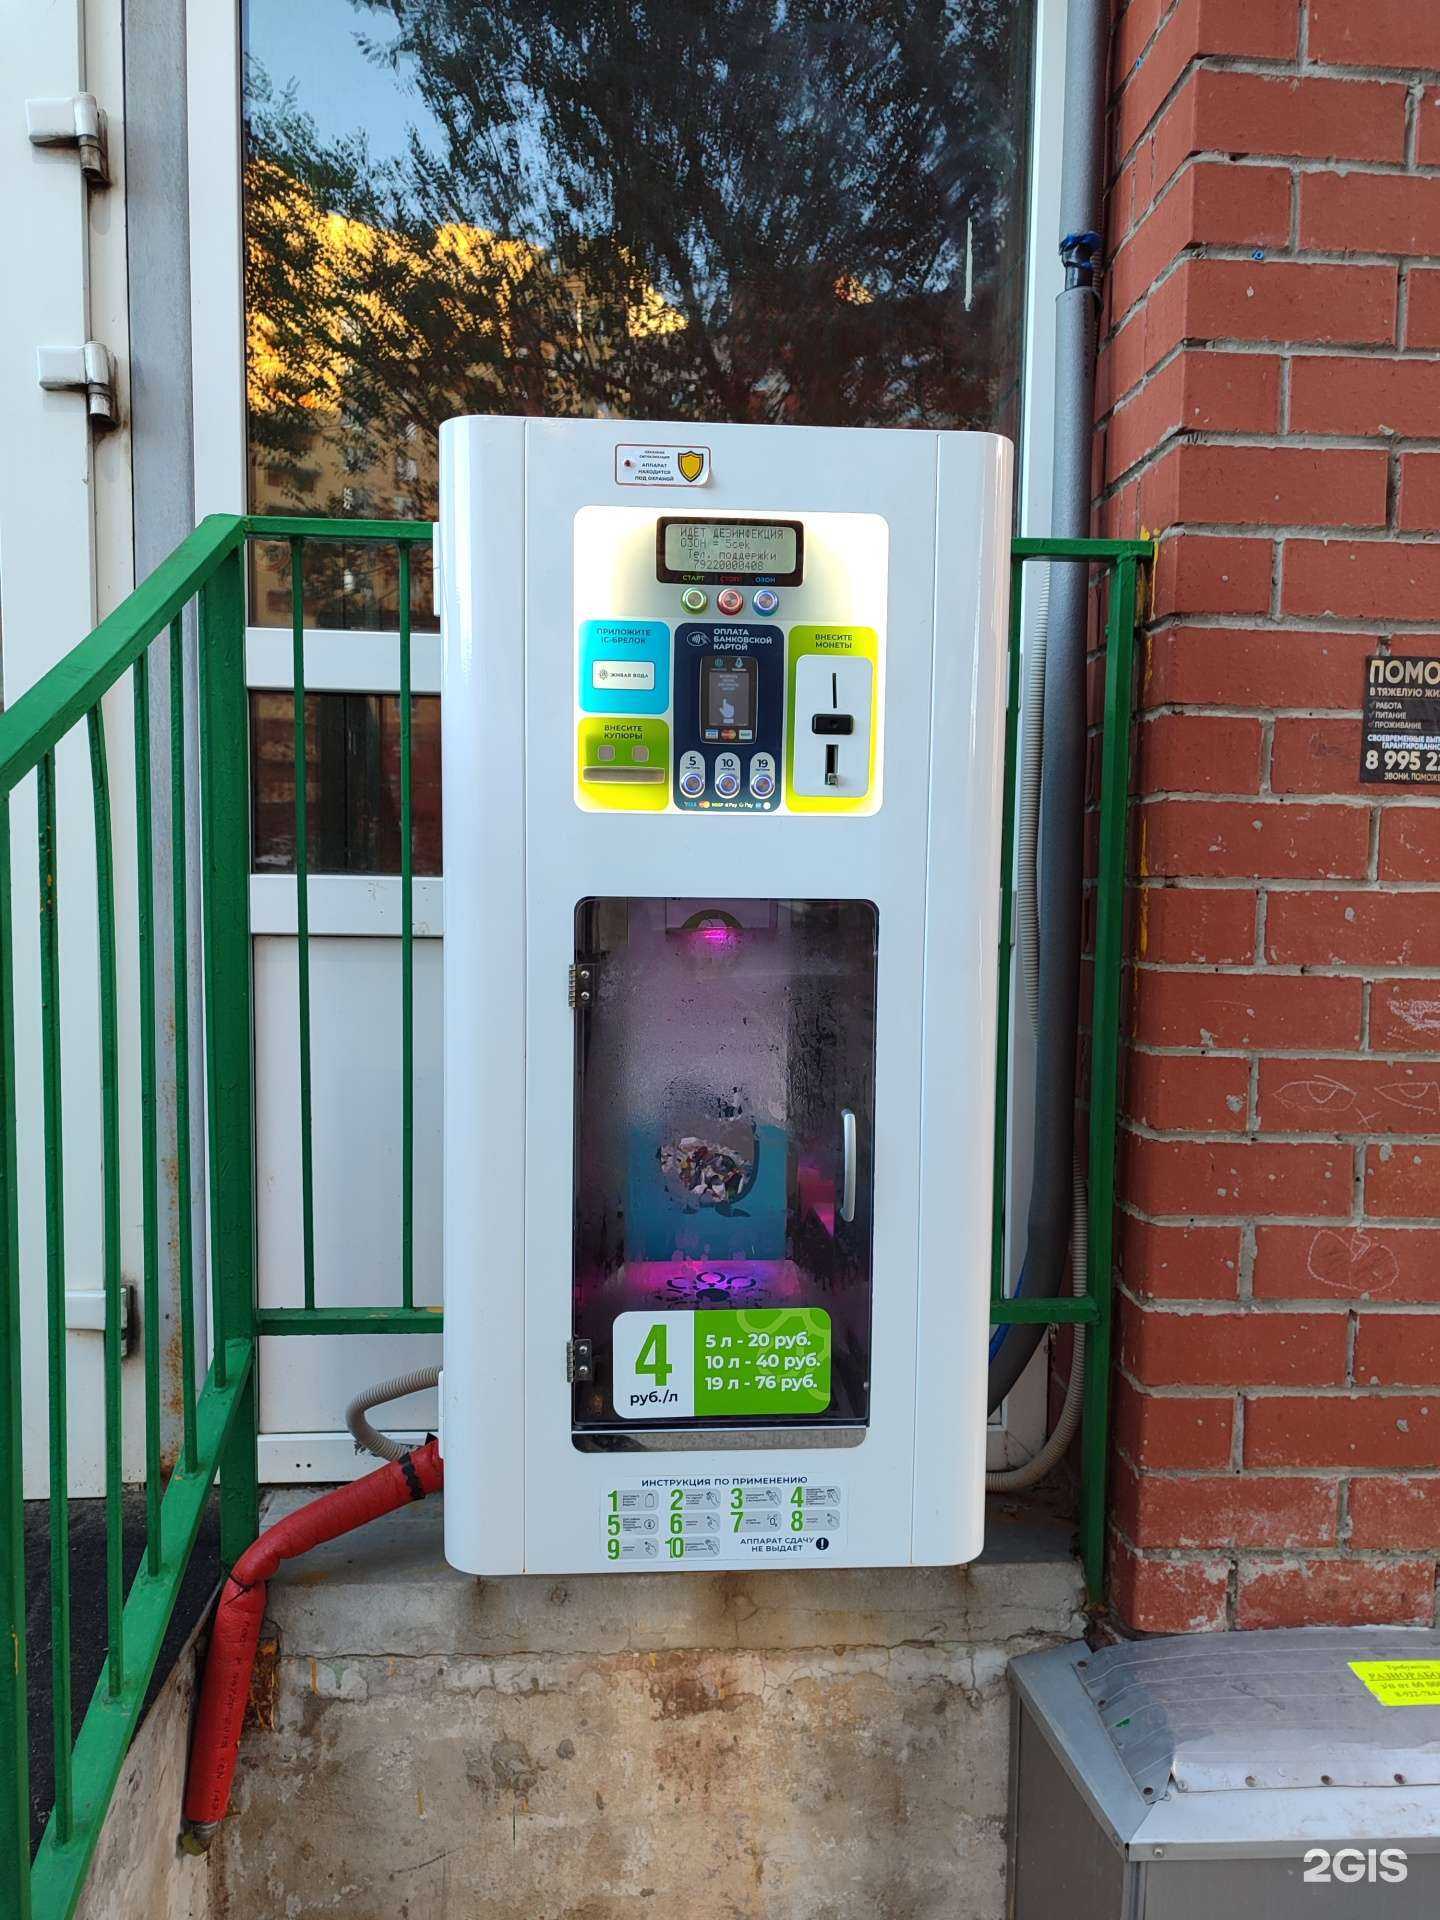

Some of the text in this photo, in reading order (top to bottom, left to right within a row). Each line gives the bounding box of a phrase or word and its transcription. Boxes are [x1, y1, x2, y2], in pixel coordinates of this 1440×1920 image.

[680, 527, 784, 540] ИДЕТ ДЕЗИНФЕКЦИЯ
[680, 538, 706, 548] ОЗОН
[688, 549, 777, 560] Тел. поддержки
[597, 628, 652, 636] ПРИЛОЖИТЕ
[713, 636, 772, 644] БАНКОВСКОЙ
[1369, 688, 1376, 696] В
[1377, 688, 1422, 697] ТЯЖЕЛУЮ
[1375, 702, 1402, 710] РАБОТА
[1375, 711, 1406, 719] ПИТАНИЕ
[1374, 721, 1421, 729] ПРОЖИВАНИЕ
[689, 756, 697, 766] 5
[722, 758, 734, 768] 10
[756, 759, 768, 768] 19
[1365, 750, 1440, 771] 8 995 2
[705, 1335, 716, 1348] 5
[720, 1337, 732, 1347] л
[748, 1334, 770, 1347] 20
[775, 1332, 811, 1349] руб.
[634, 1324, 673, 1387] 4
[705, 1356, 724, 1369] 10
[728, 1357, 740, 1369] л
[756, 1355, 779, 1368] 40
[784, 1353, 821, 1370] руб.
[705, 1377, 724, 1390] 19
[727, 1378, 739, 1390] л
[755, 1376, 777, 1389] 76
[781, 1374, 818, 1392] руб.
[630, 1390, 678, 1406] руб./л
[641, 1479, 711, 1487] ИНСТРУКЦИЯ
[732, 1476, 808, 1485] ПРИМЕНЕНИЮ
[608, 1490, 618, 1512] 1
[670, 1489, 683, 1511] 2
[730, 1487, 743, 1509] 3
[790, 1486, 804, 1508] 4
[608, 1514, 620, 1536] 5
[670, 1513, 683, 1534] 6
[730, 1511, 744, 1533] 7
[790, 1510, 803, 1532] 8
[608, 1538, 620, 1560] 9
[665, 1537, 684, 1558] 10
